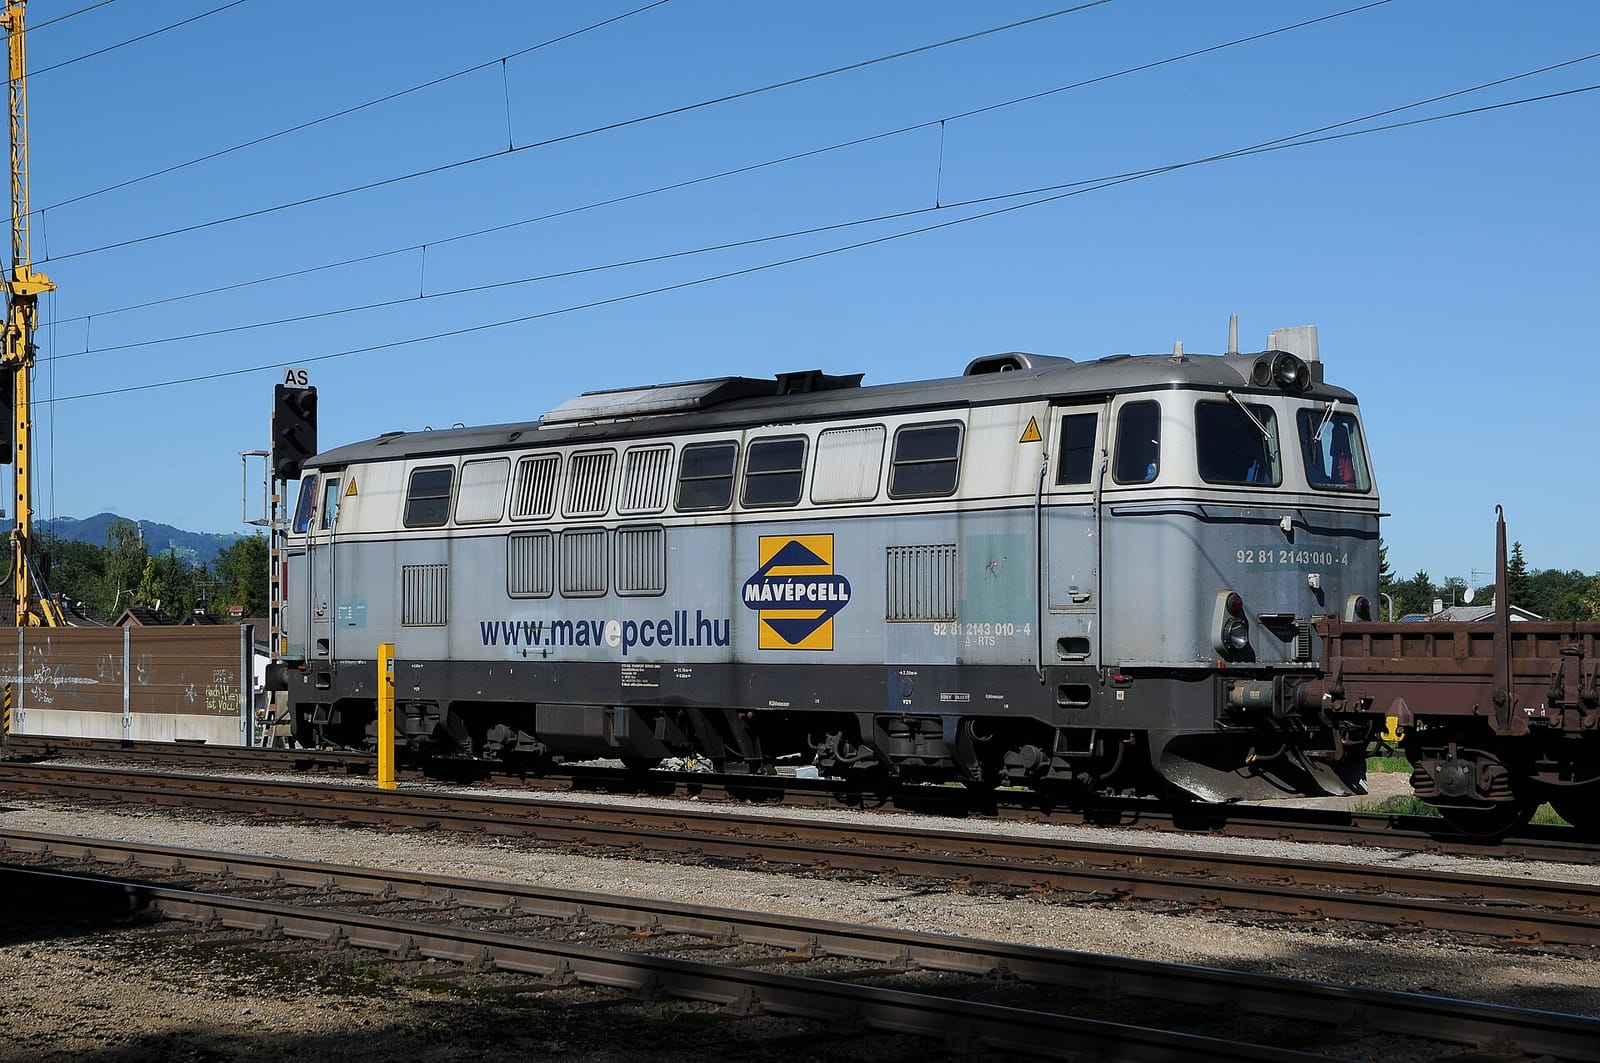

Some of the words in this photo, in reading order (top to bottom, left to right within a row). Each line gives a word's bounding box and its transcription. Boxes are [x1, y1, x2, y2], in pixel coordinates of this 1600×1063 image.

[285, 369, 308, 386] AS
[1236, 550, 1254, 563] 92
[1258, 550, 1274, 563] 81
[1279, 550, 1310, 564] 2143
[745, 578, 849, 602] MÁVÉPCELL
[480, 609, 730, 656] www.mavepcell.hu
[933, 622, 947, 636] 92
[950, 622, 962, 636] 81
[966, 622, 991, 636] 2143
